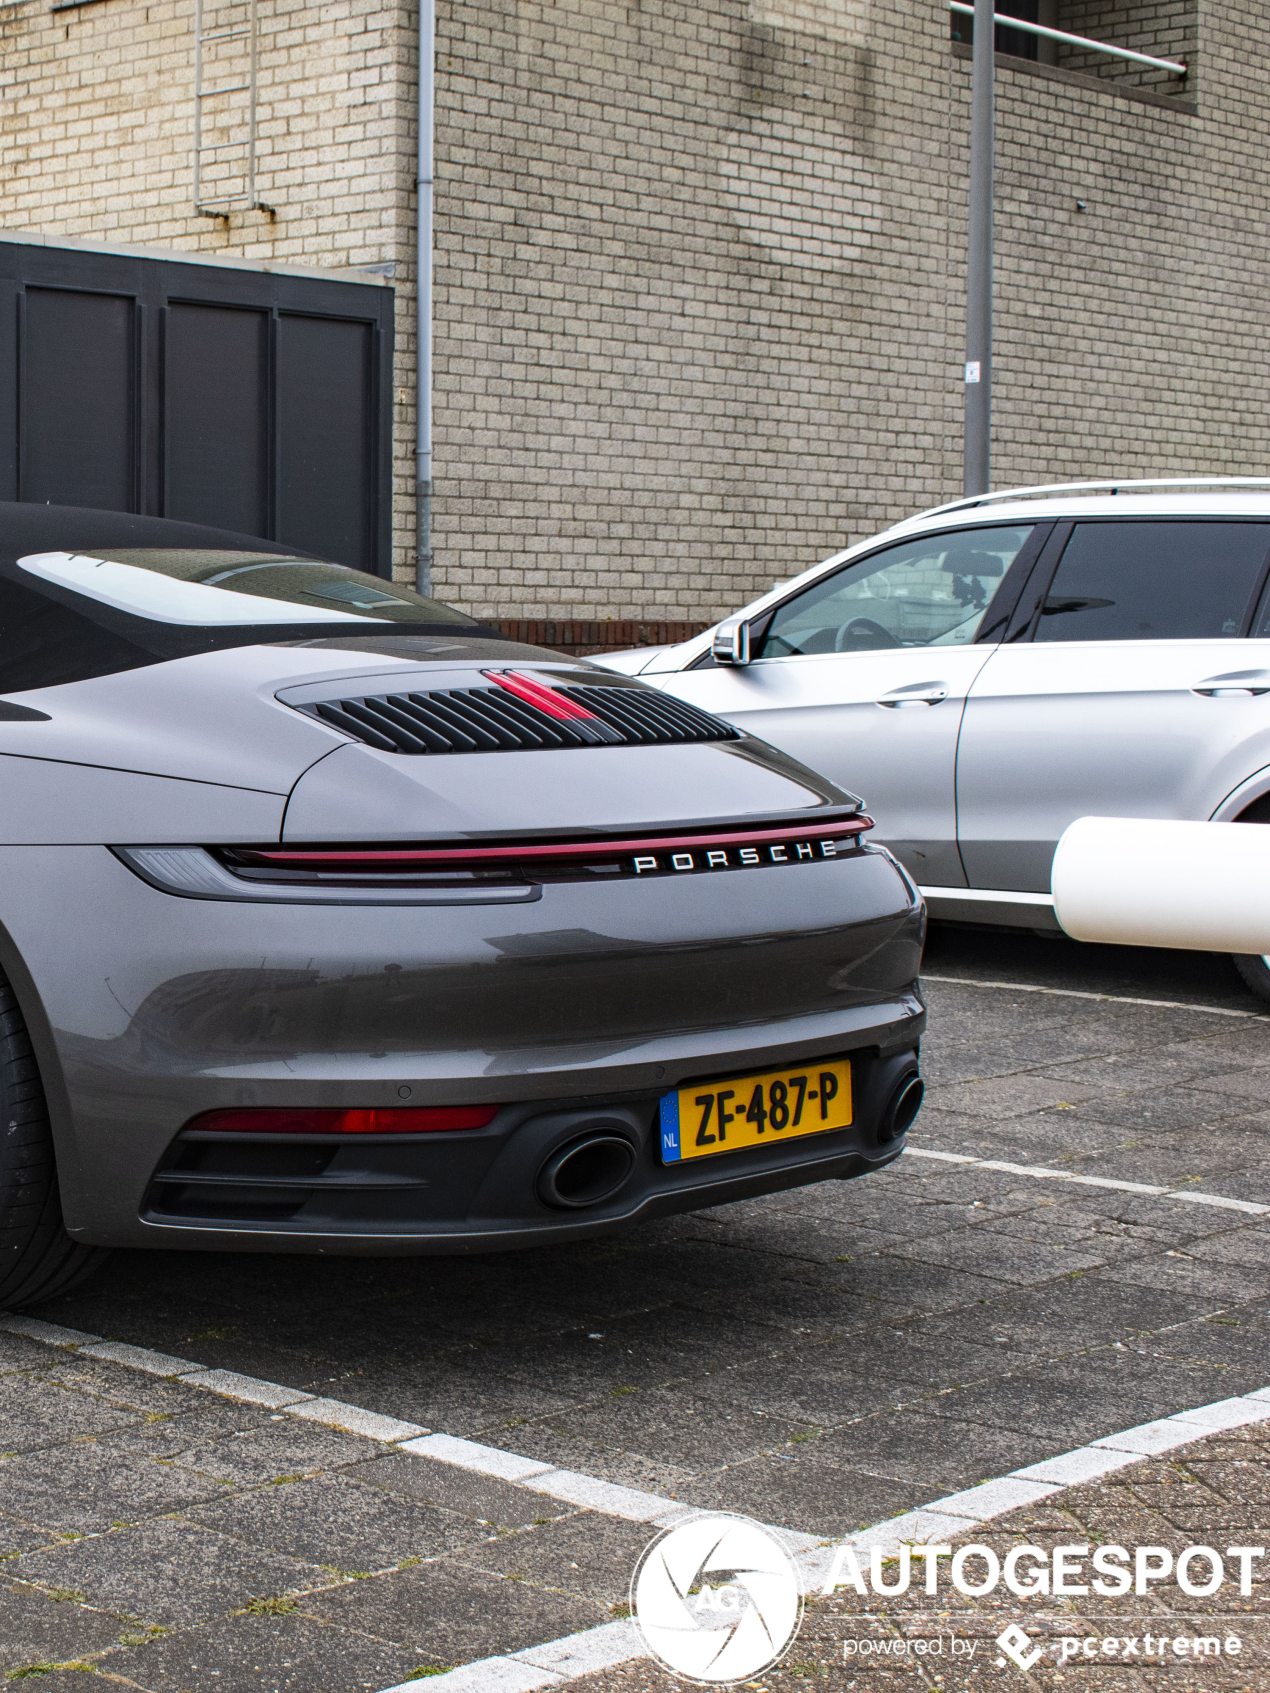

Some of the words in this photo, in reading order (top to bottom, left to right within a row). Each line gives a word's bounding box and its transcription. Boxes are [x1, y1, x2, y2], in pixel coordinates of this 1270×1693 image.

[633, 841, 837, 873] PORSCHE
[695, 1071, 838, 1147] ZF-487-P
[663, 1133, 678, 1149] NL
